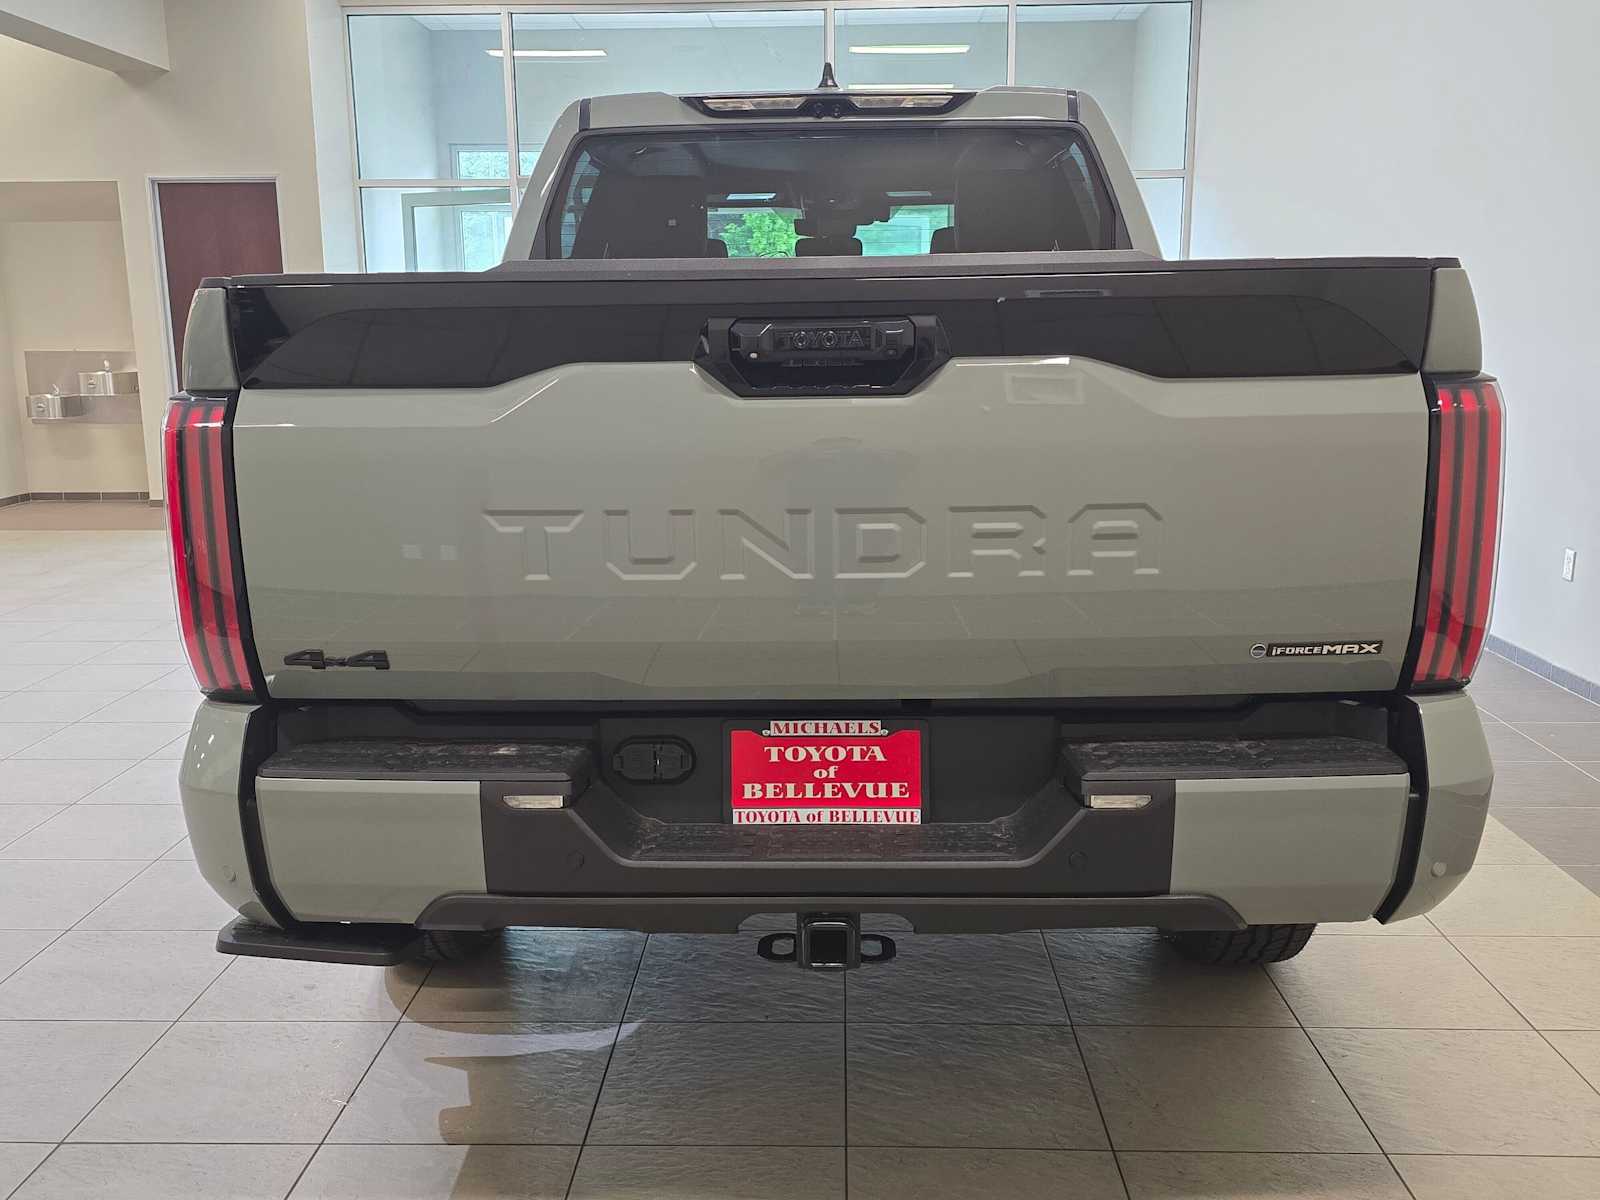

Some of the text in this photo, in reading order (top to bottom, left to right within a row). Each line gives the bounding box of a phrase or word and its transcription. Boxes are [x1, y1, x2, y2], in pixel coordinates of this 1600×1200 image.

[783, 331, 864, 348] TOYOTA
[482, 503, 1163, 581] TUNDRA
[773, 722, 880, 734] MICHAELS
[764, 746, 887, 762] TOYOTA
[813, 766, 838, 779] of
[742, 782, 909, 799] BELLEVUE
[735, 811, 920, 823] TOYOTA of BELLEVUE
